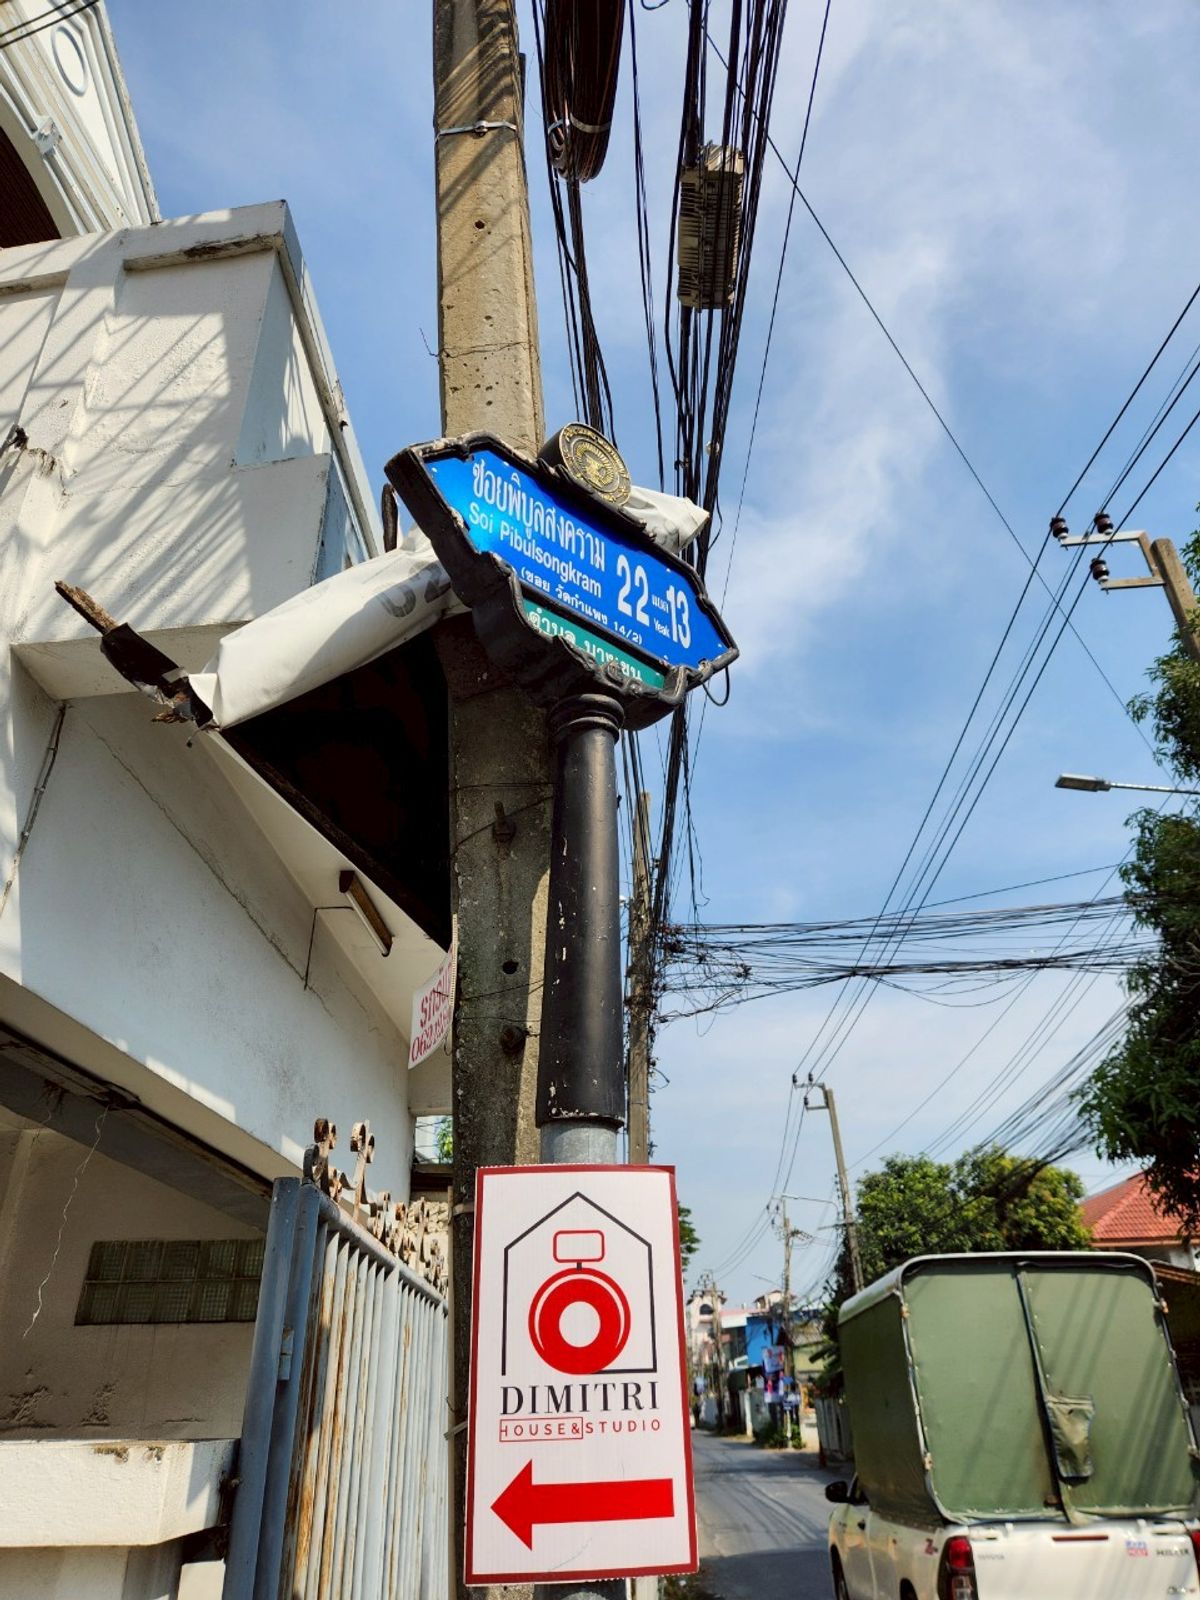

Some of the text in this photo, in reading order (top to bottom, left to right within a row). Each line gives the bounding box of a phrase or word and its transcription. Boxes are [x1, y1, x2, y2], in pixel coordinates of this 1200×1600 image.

[468, 502, 602, 598] Soi Pibulsongkram
[472, 459, 606, 572] ซอยพิบูลสงคราม
[616, 554, 650, 627] 22
[666, 585, 692, 649] 13
[613, 621, 643, 646] 14/2)
[500, 1381, 660, 1415] DIMITRI
